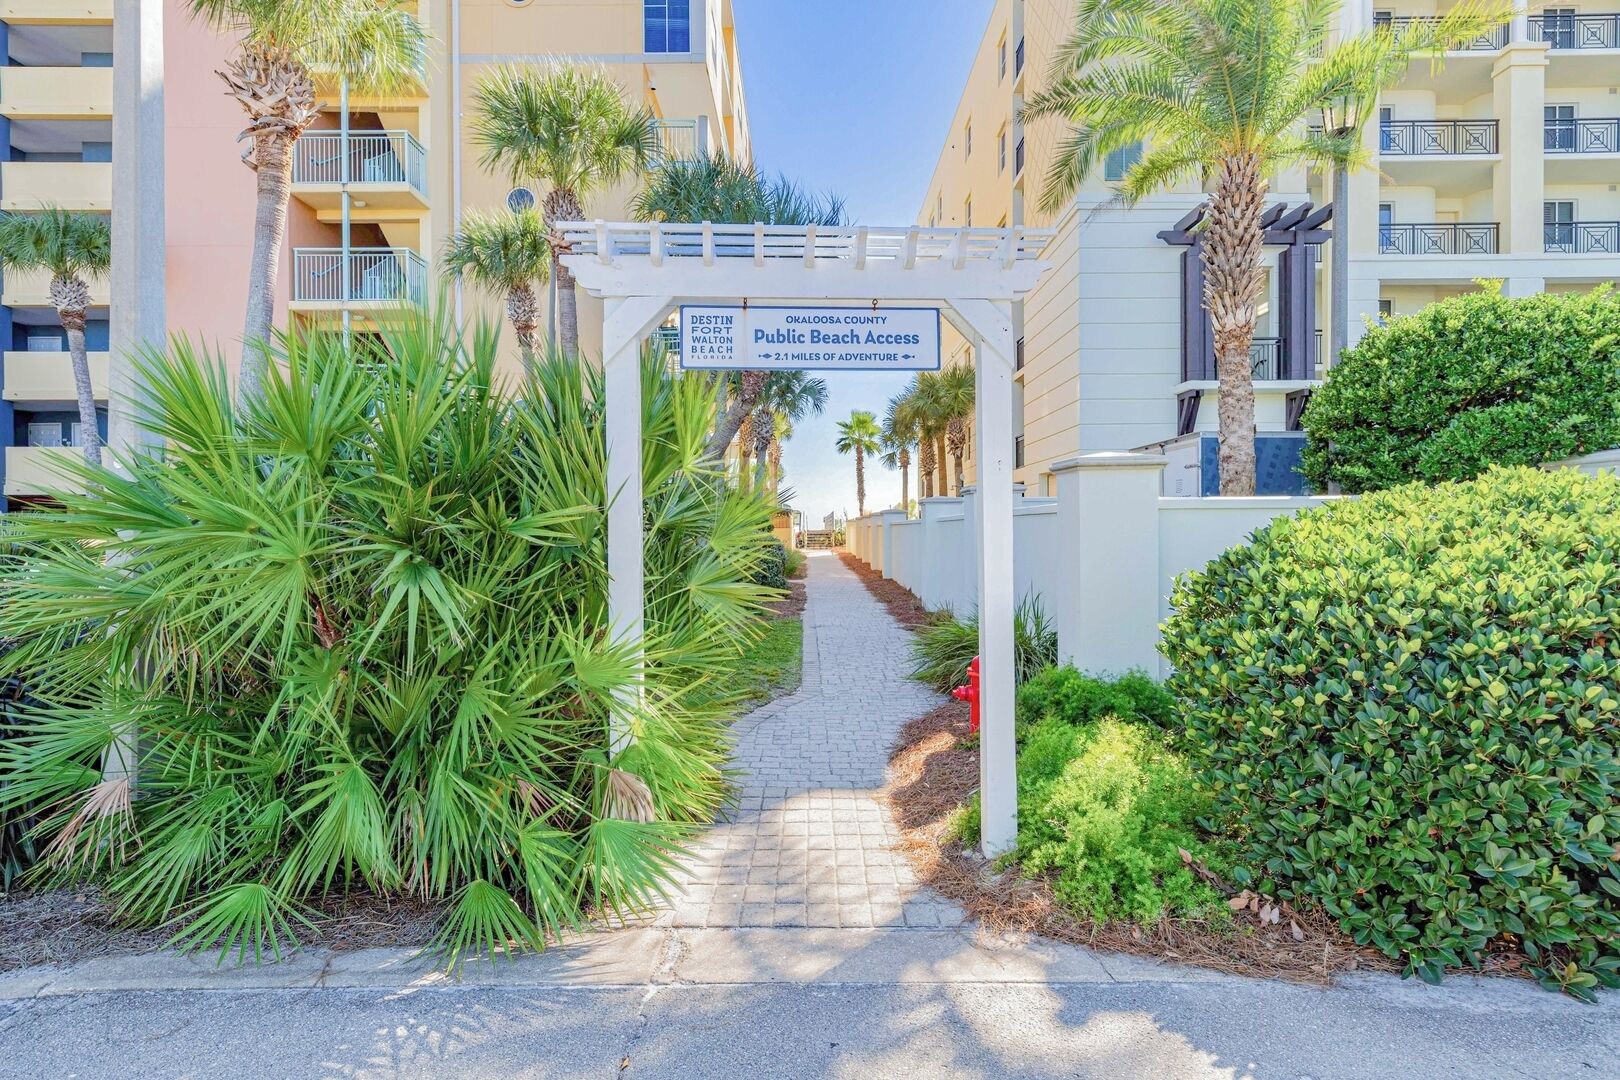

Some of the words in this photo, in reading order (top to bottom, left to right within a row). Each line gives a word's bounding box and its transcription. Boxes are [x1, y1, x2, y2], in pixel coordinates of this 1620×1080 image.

[691, 315, 733, 326] DESTIN
[785, 316, 841, 325] OKALOOSA
[843, 316, 888, 325] COUNTY
[691, 326, 733, 335] FORT
[691, 336, 733, 344] WALTON
[754, 329, 805, 344] Public
[811, 329, 860, 344] Beach
[864, 330, 920, 344] Access
[691, 345, 733, 354] BEACH
[774, 353, 789, 361] 2.1
[791, 353, 821, 361] MILES
[823, 353, 837, 361] OF
[838, 353, 899, 361] ADVENTURE
